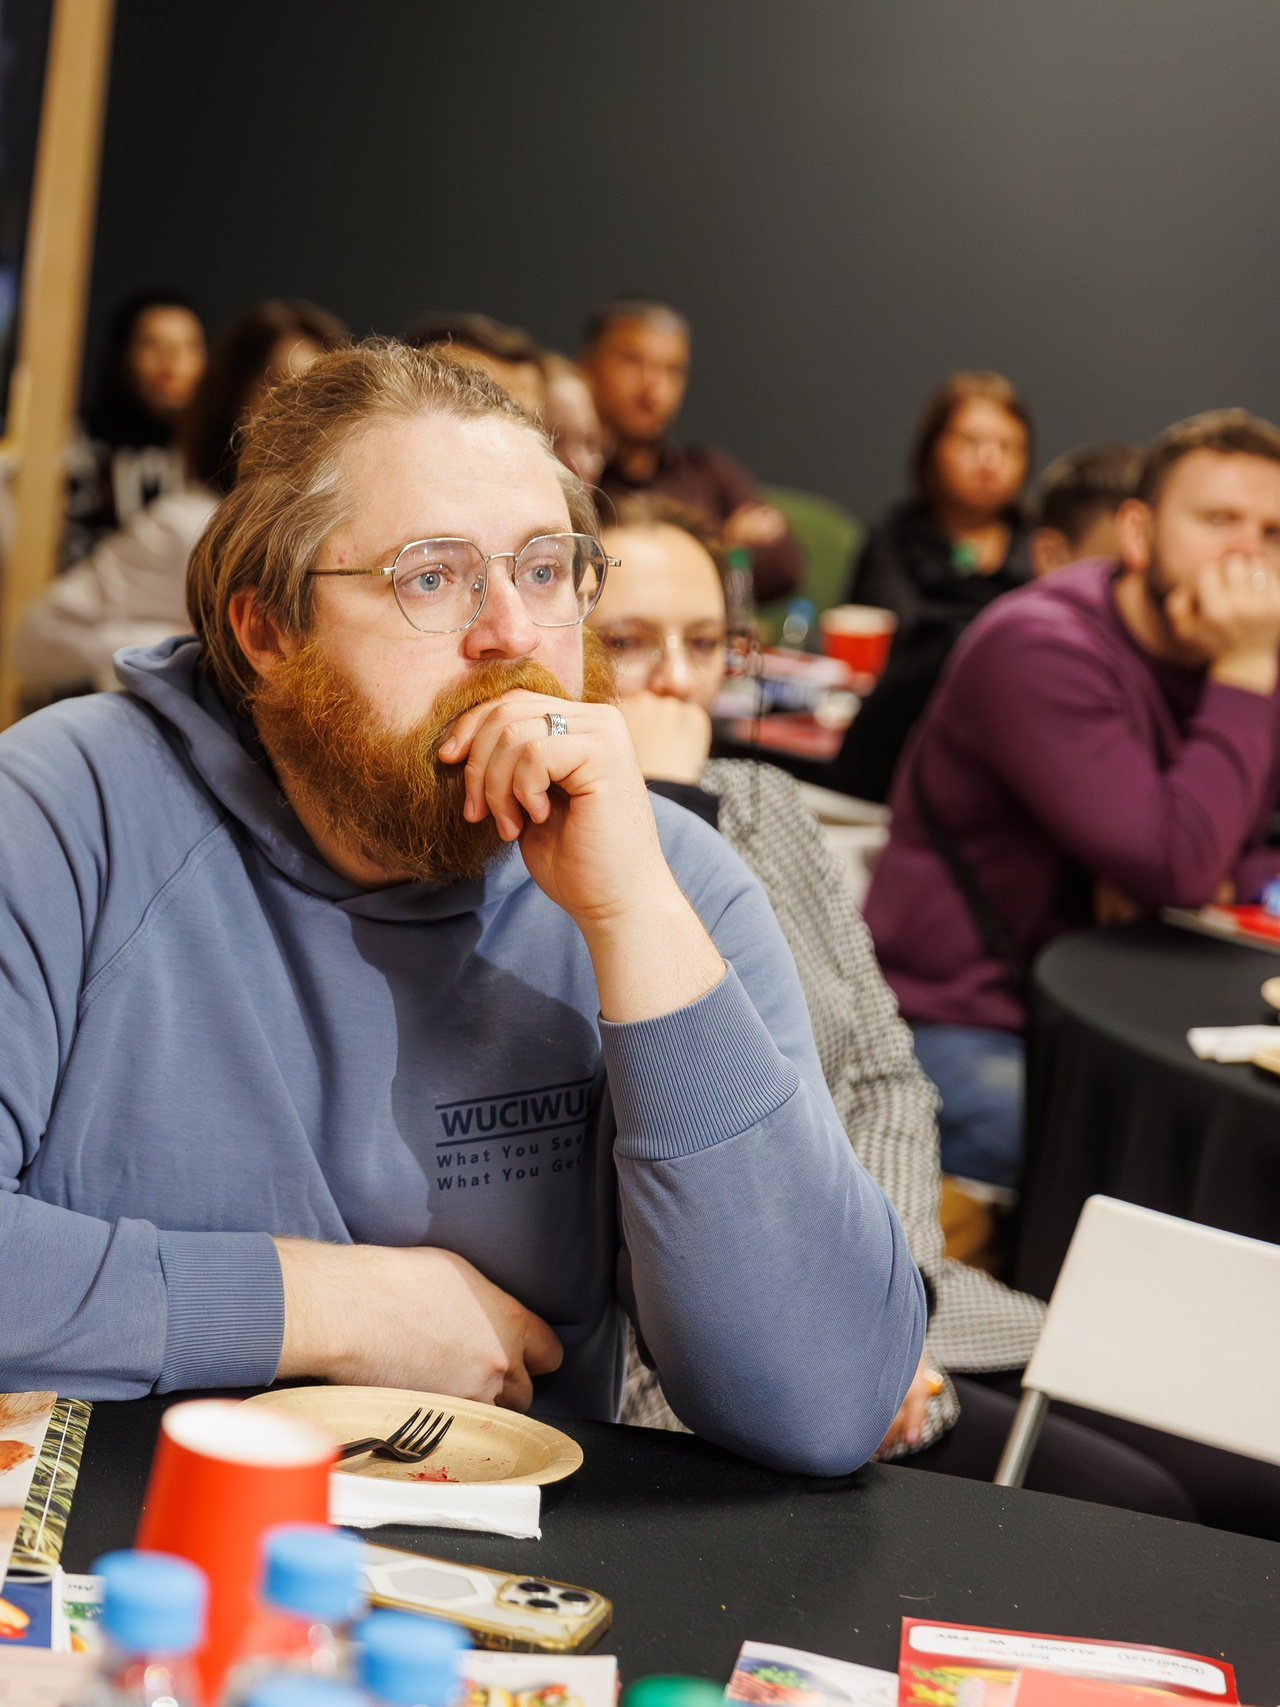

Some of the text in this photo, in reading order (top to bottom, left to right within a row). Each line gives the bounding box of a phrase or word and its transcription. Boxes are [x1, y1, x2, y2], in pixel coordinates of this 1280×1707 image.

[440, 1088, 588, 1138] WUCIWU
[436, 1134, 584, 1169] What You See
[436, 1172, 491, 1191] What
[502, 1166, 540, 1182] You
